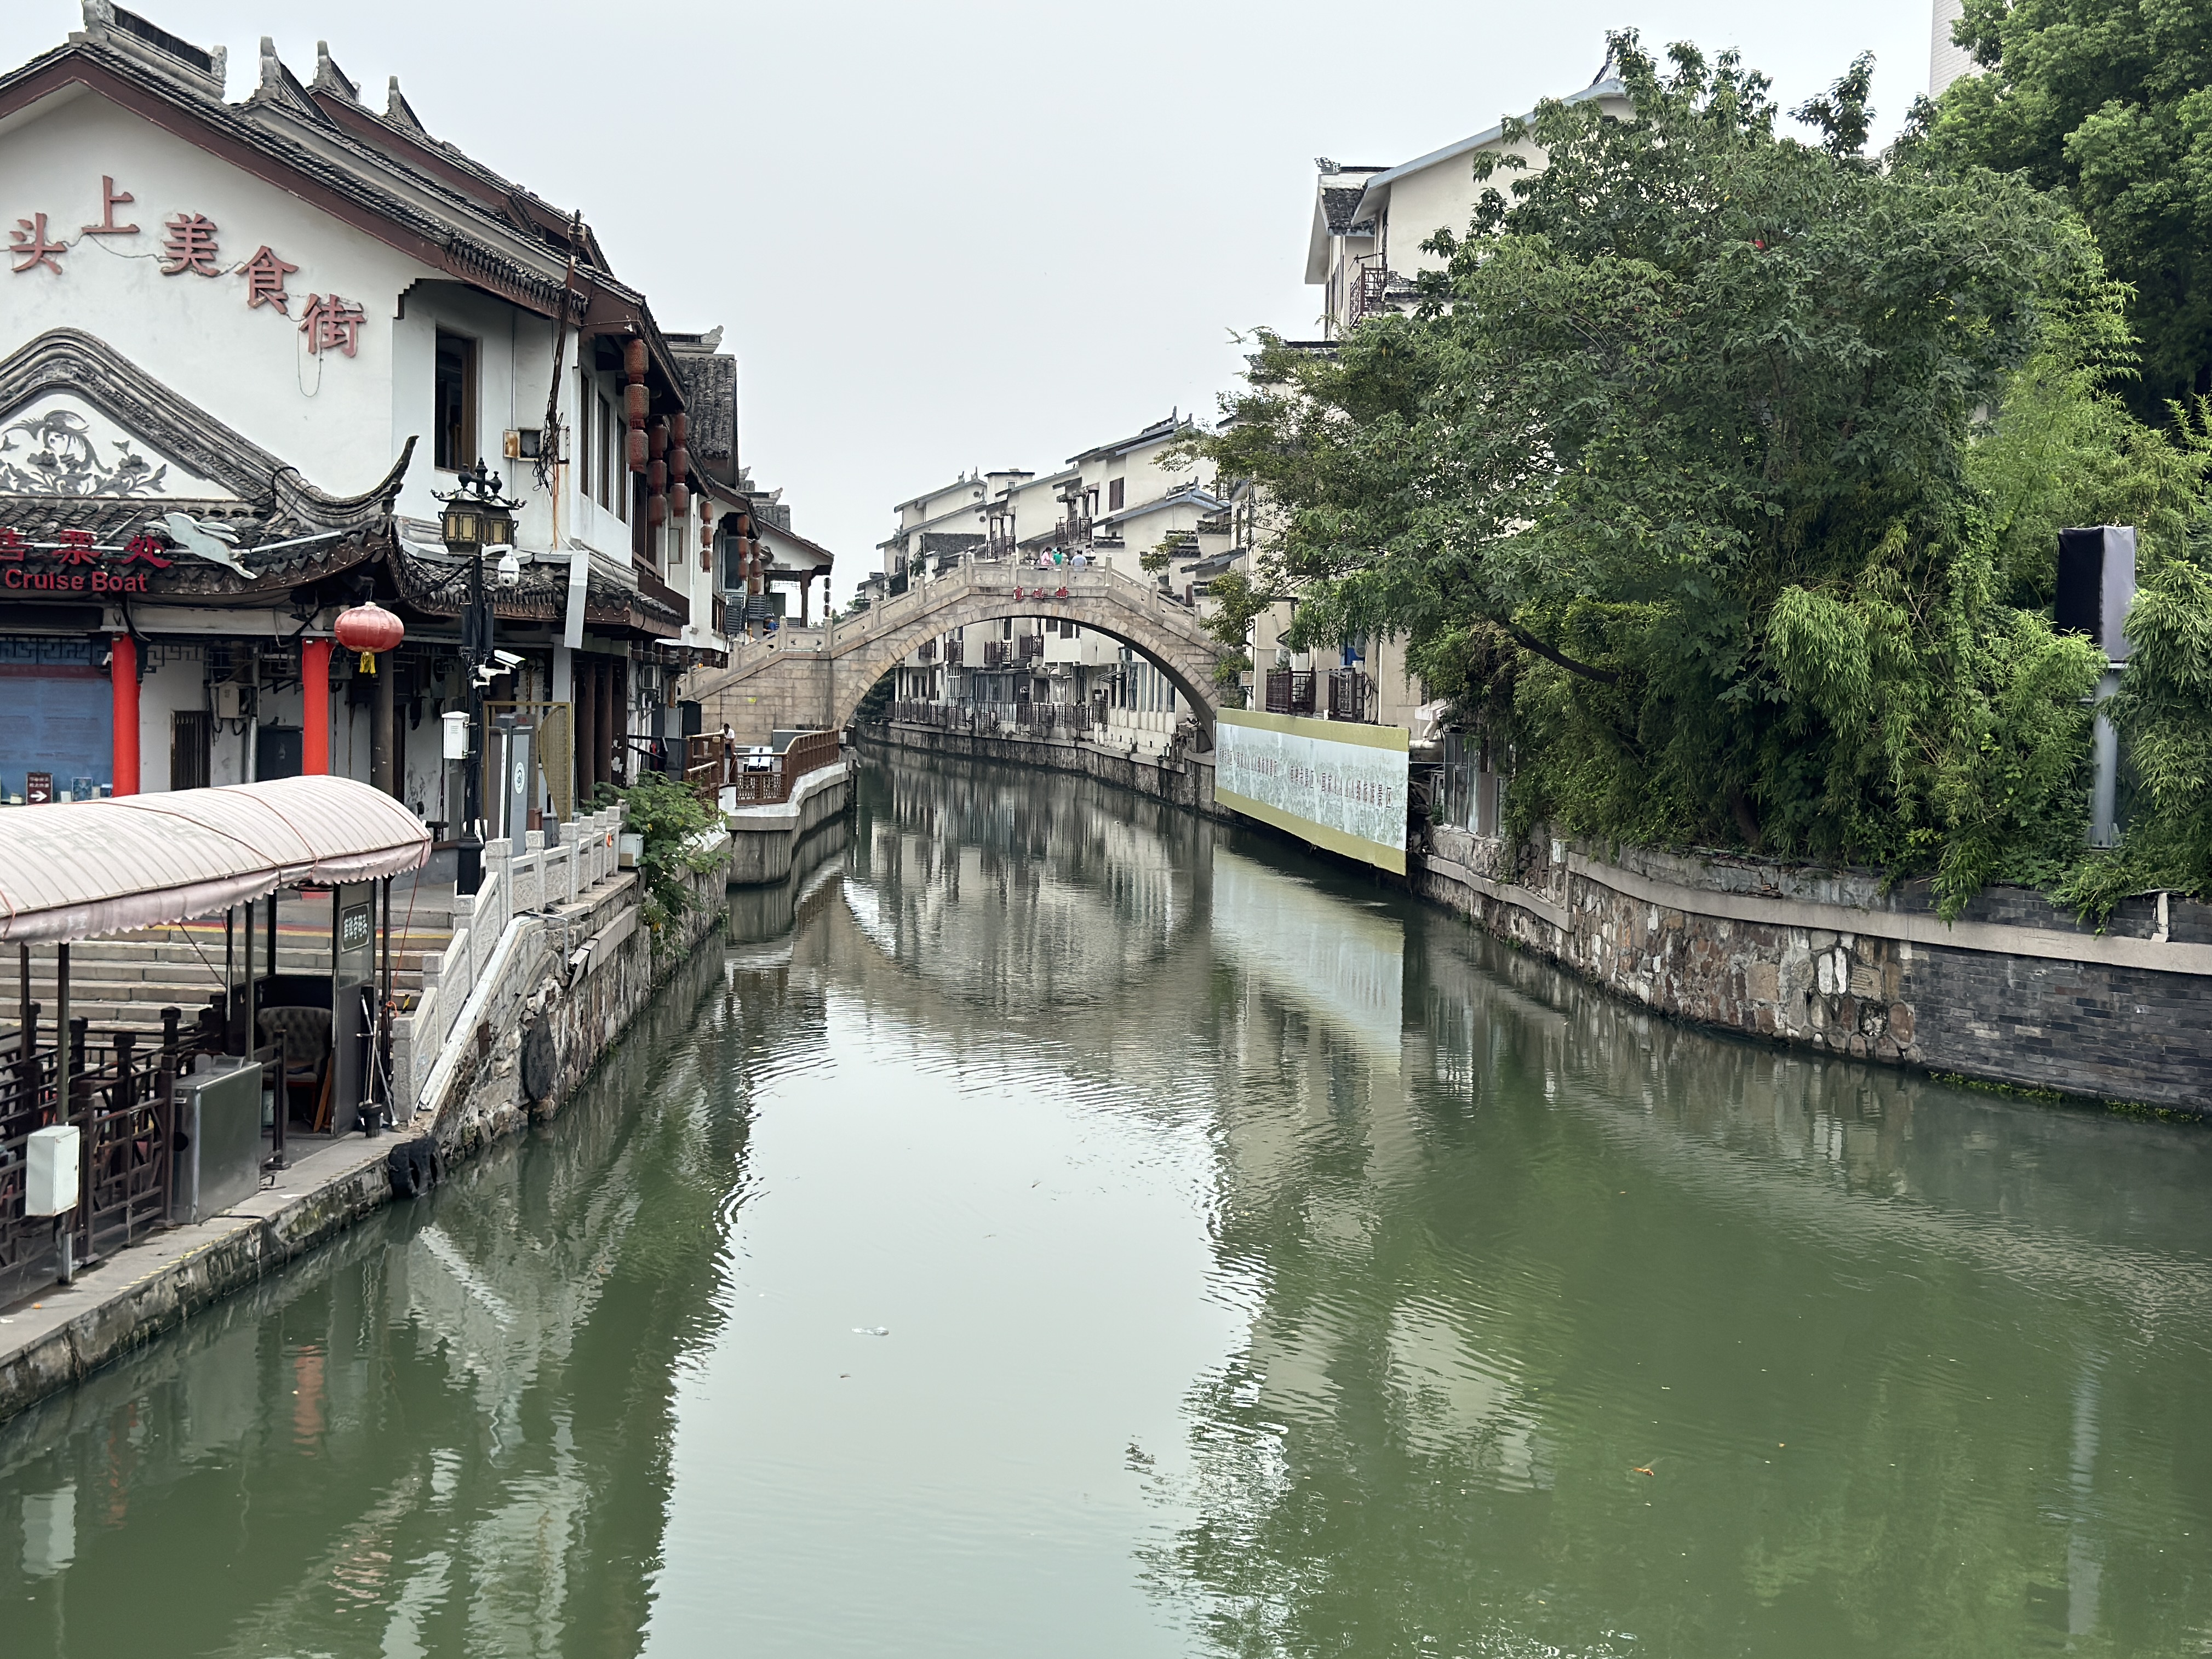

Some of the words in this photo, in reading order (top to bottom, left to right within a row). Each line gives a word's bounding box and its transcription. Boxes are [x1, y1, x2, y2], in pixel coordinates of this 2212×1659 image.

[9, 175, 367, 358] 头上美食街
[5, 568, 84, 591] Cruise
[91, 571, 148, 592] Boat
